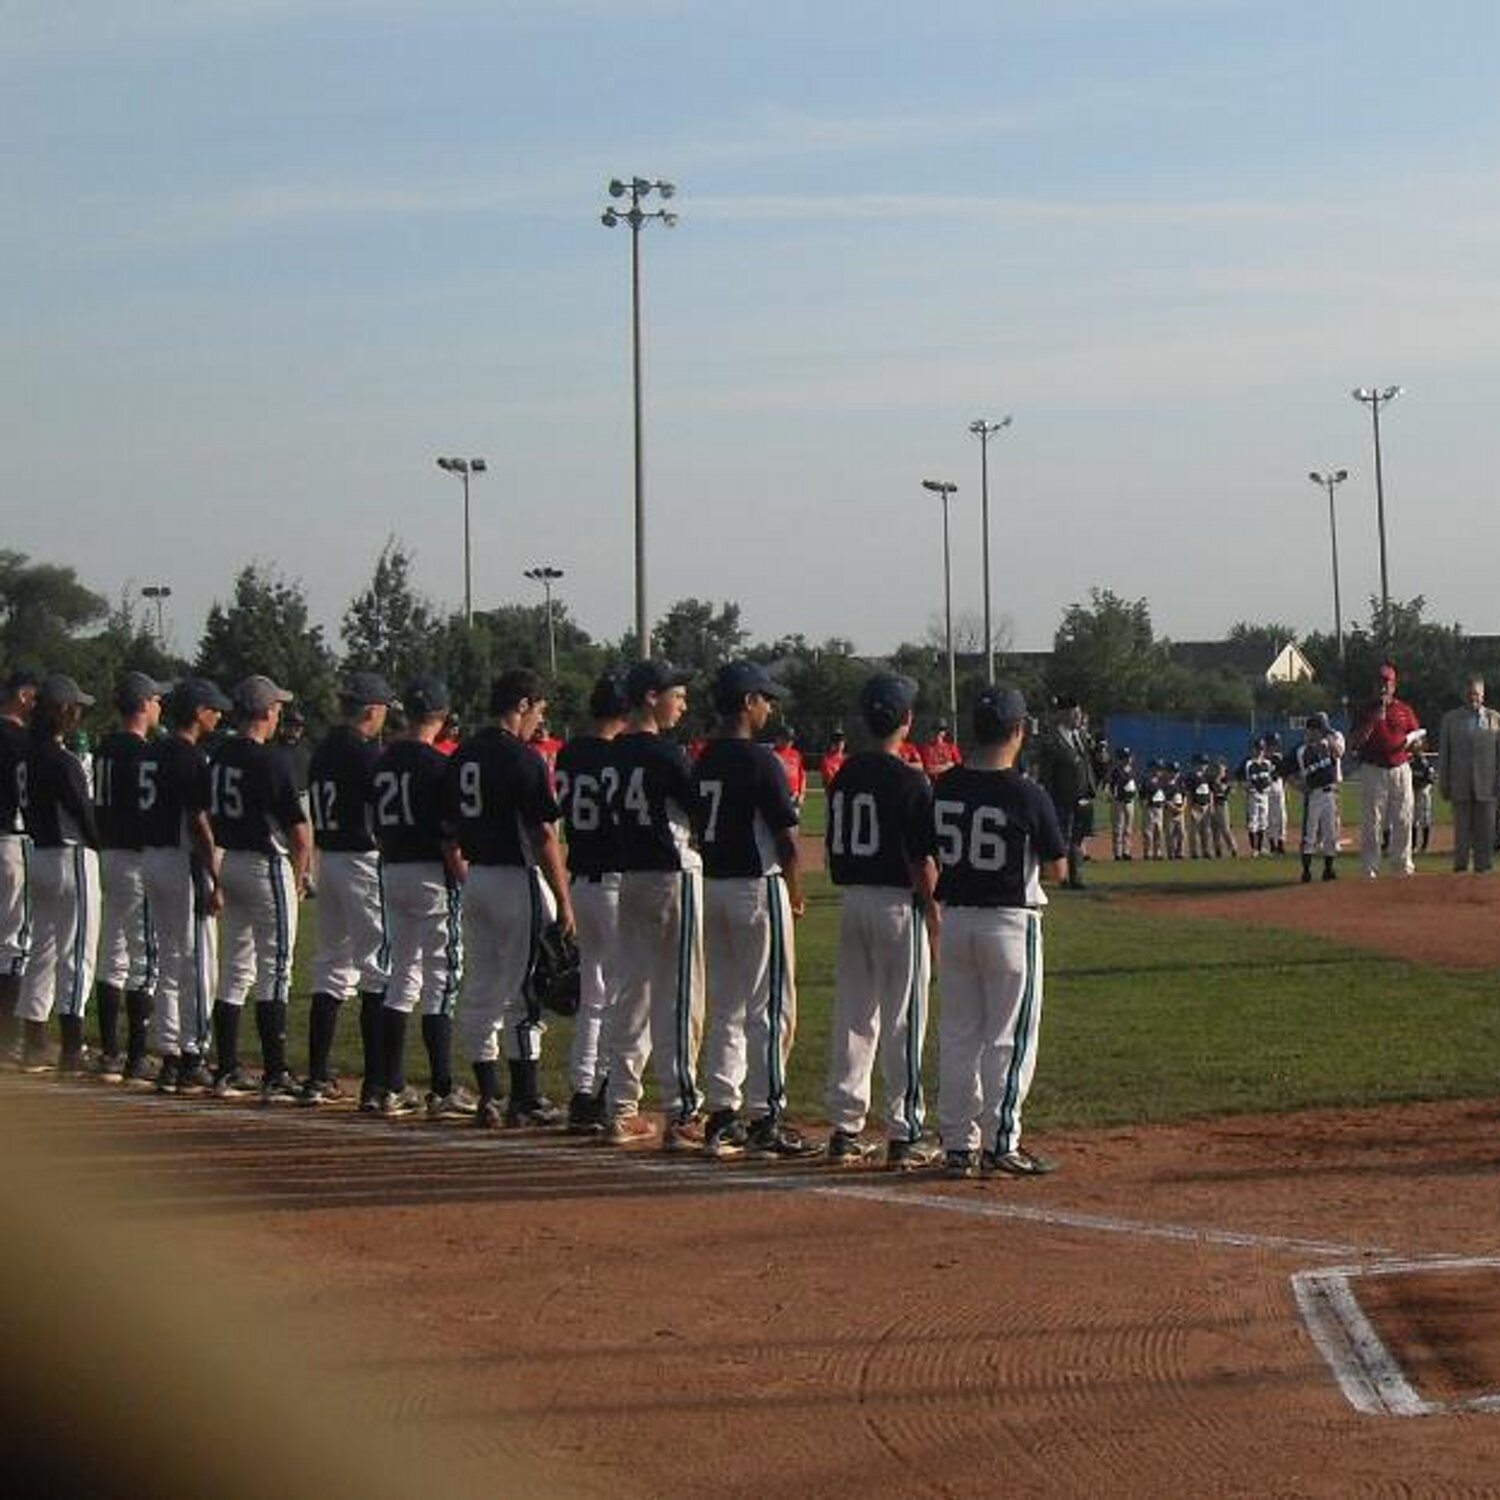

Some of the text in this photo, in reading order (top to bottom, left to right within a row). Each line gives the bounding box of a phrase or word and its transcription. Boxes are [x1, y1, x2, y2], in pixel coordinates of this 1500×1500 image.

[137, 760, 158, 810] 5
[210, 763, 243, 819] 15
[311, 781, 338, 831] 12
[375, 771, 415, 826] 21
[460, 762, 482, 818] 9
[601, 766, 652, 826] 24
[700, 780, 722, 843] 7
[831, 790, 880, 857] 10
[934, 800, 1007, 871] 56
